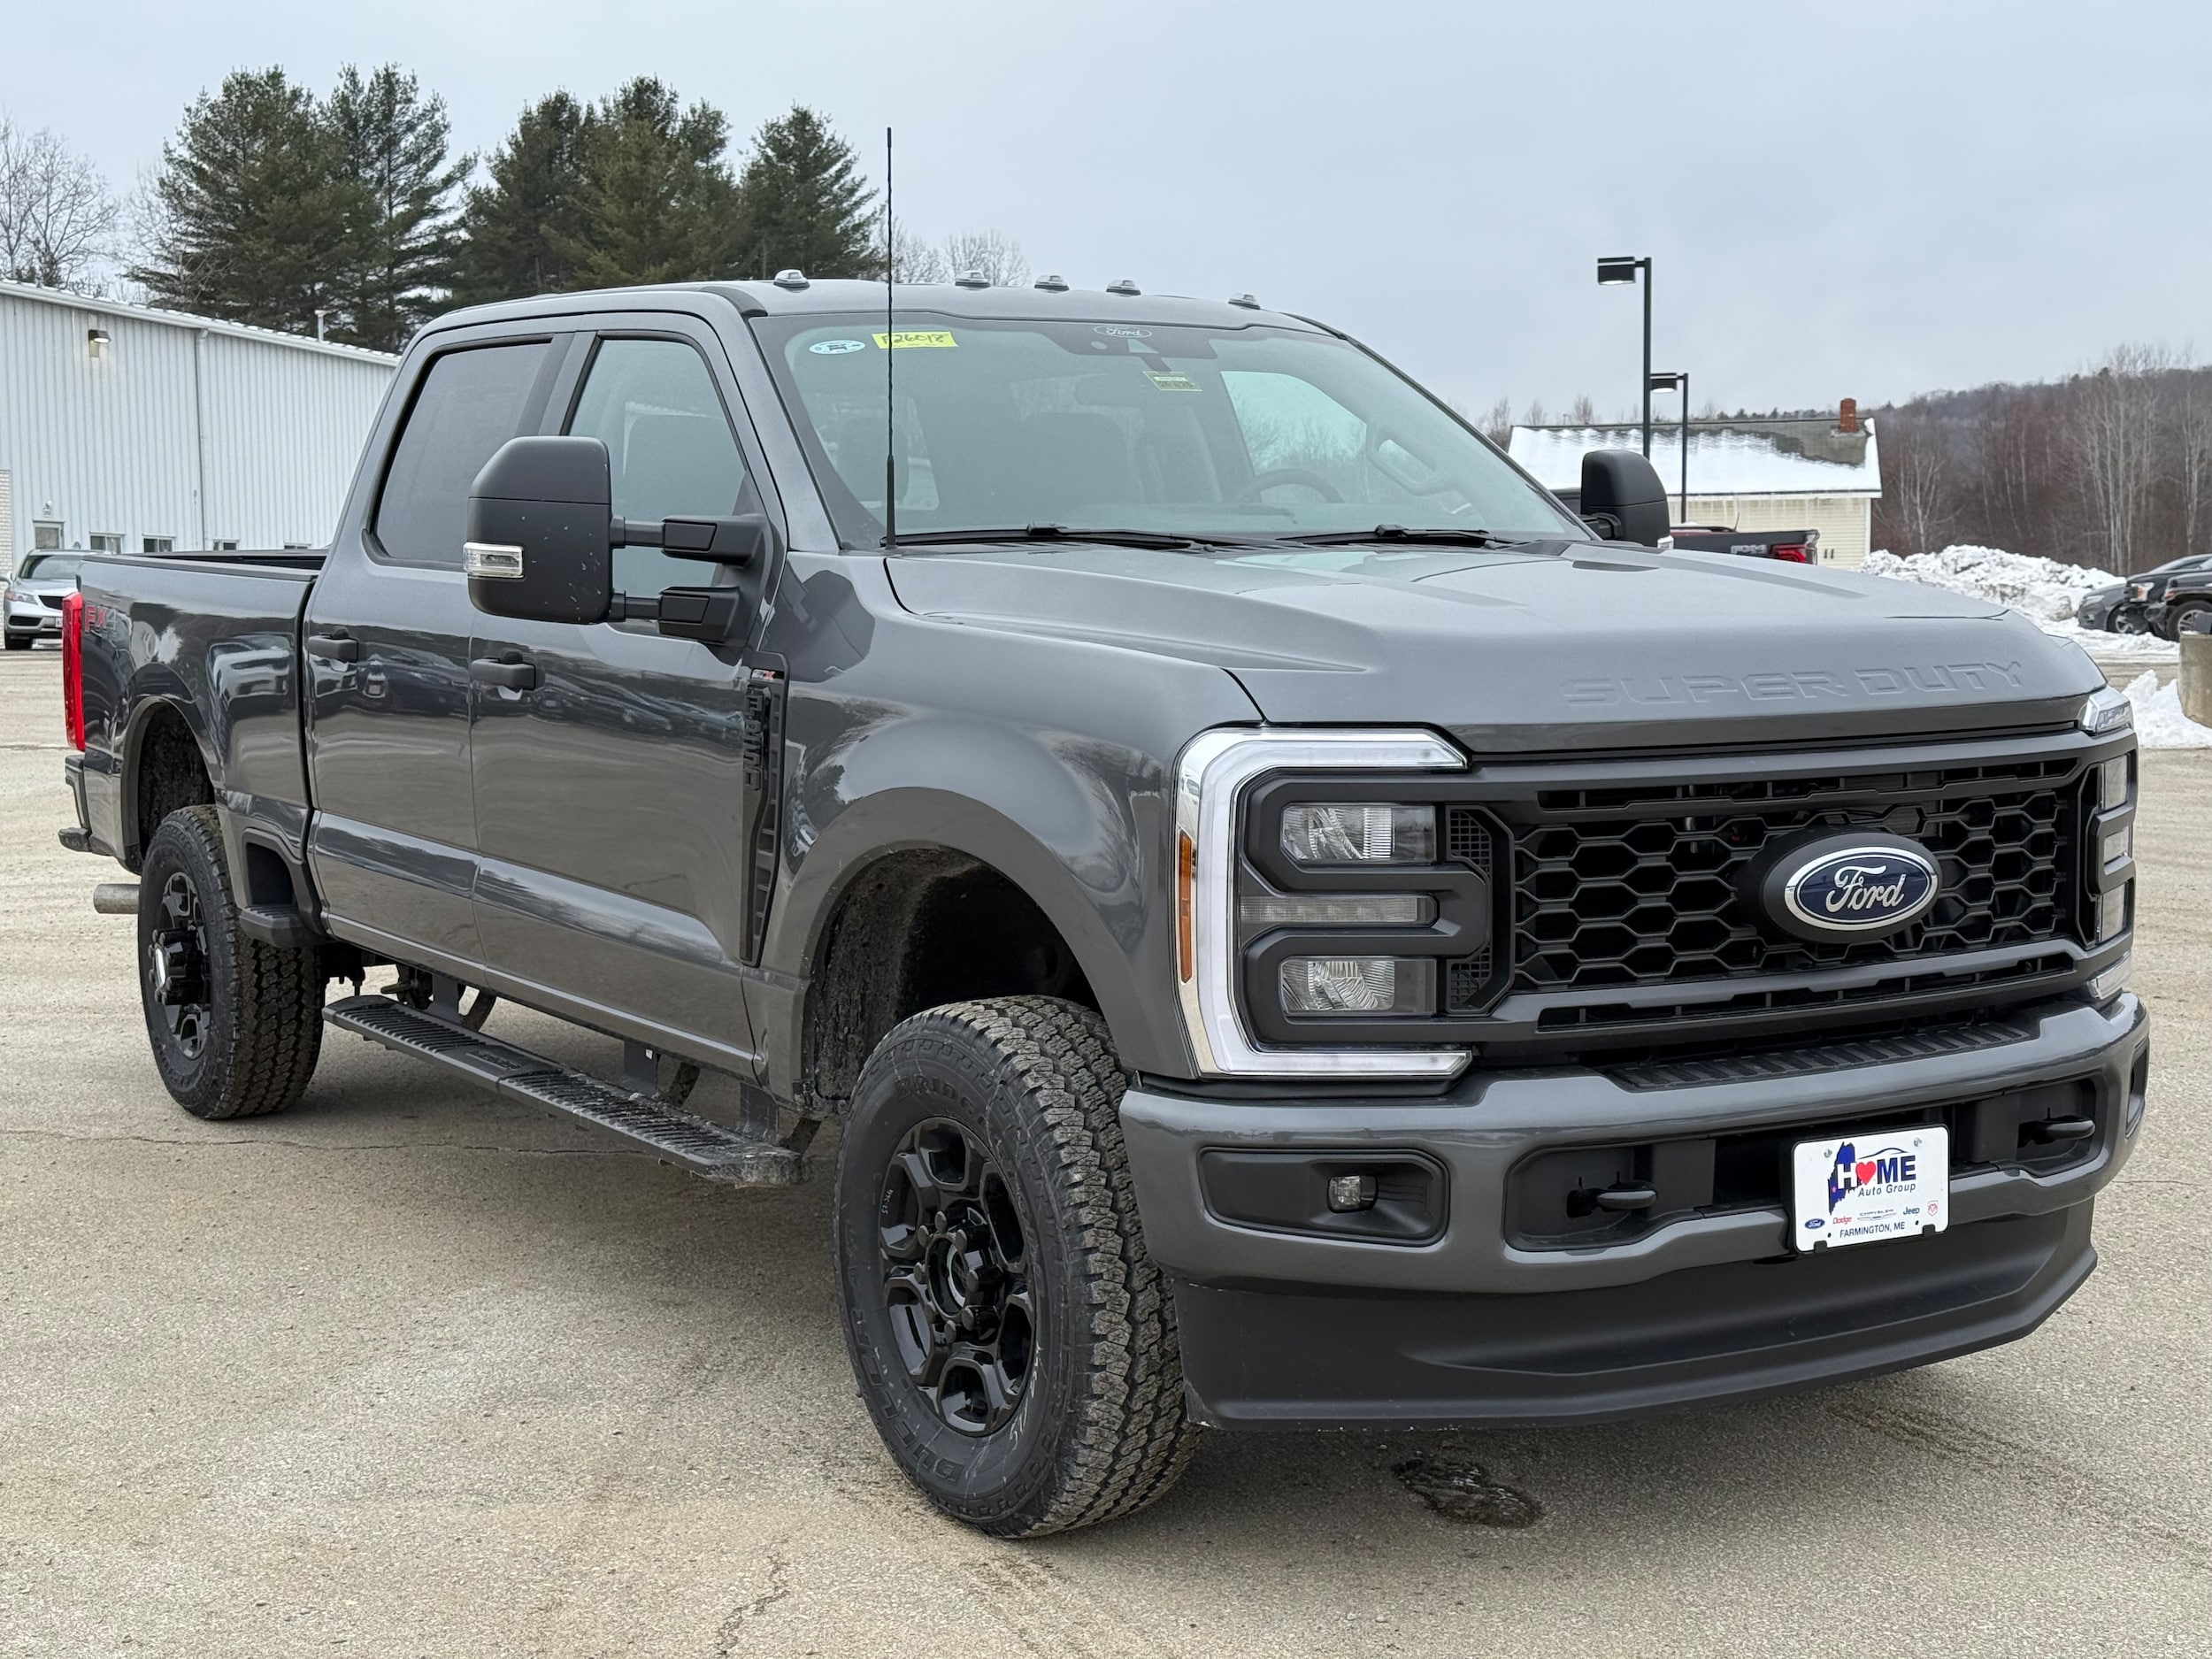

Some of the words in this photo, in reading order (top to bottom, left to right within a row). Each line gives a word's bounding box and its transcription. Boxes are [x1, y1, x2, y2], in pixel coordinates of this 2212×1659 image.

[1104, 326, 1143, 337] Ford
[84, 605, 118, 633] FX4
[1559, 671, 1851, 708] SUPER
[1854, 660, 2023, 696] DUTY
[1824, 864, 1907, 913] Ford
[1858, 1187, 1882, 1197] Auto
[1886, 1183, 1916, 1194] Group
[1902, 1206, 1920, 1216] Jeep
[1832, 1216, 1853, 1225] Dodge
[1839, 1223, 1892, 1238] FARMINGTON,
[1893, 1221, 1906, 1231] ME
